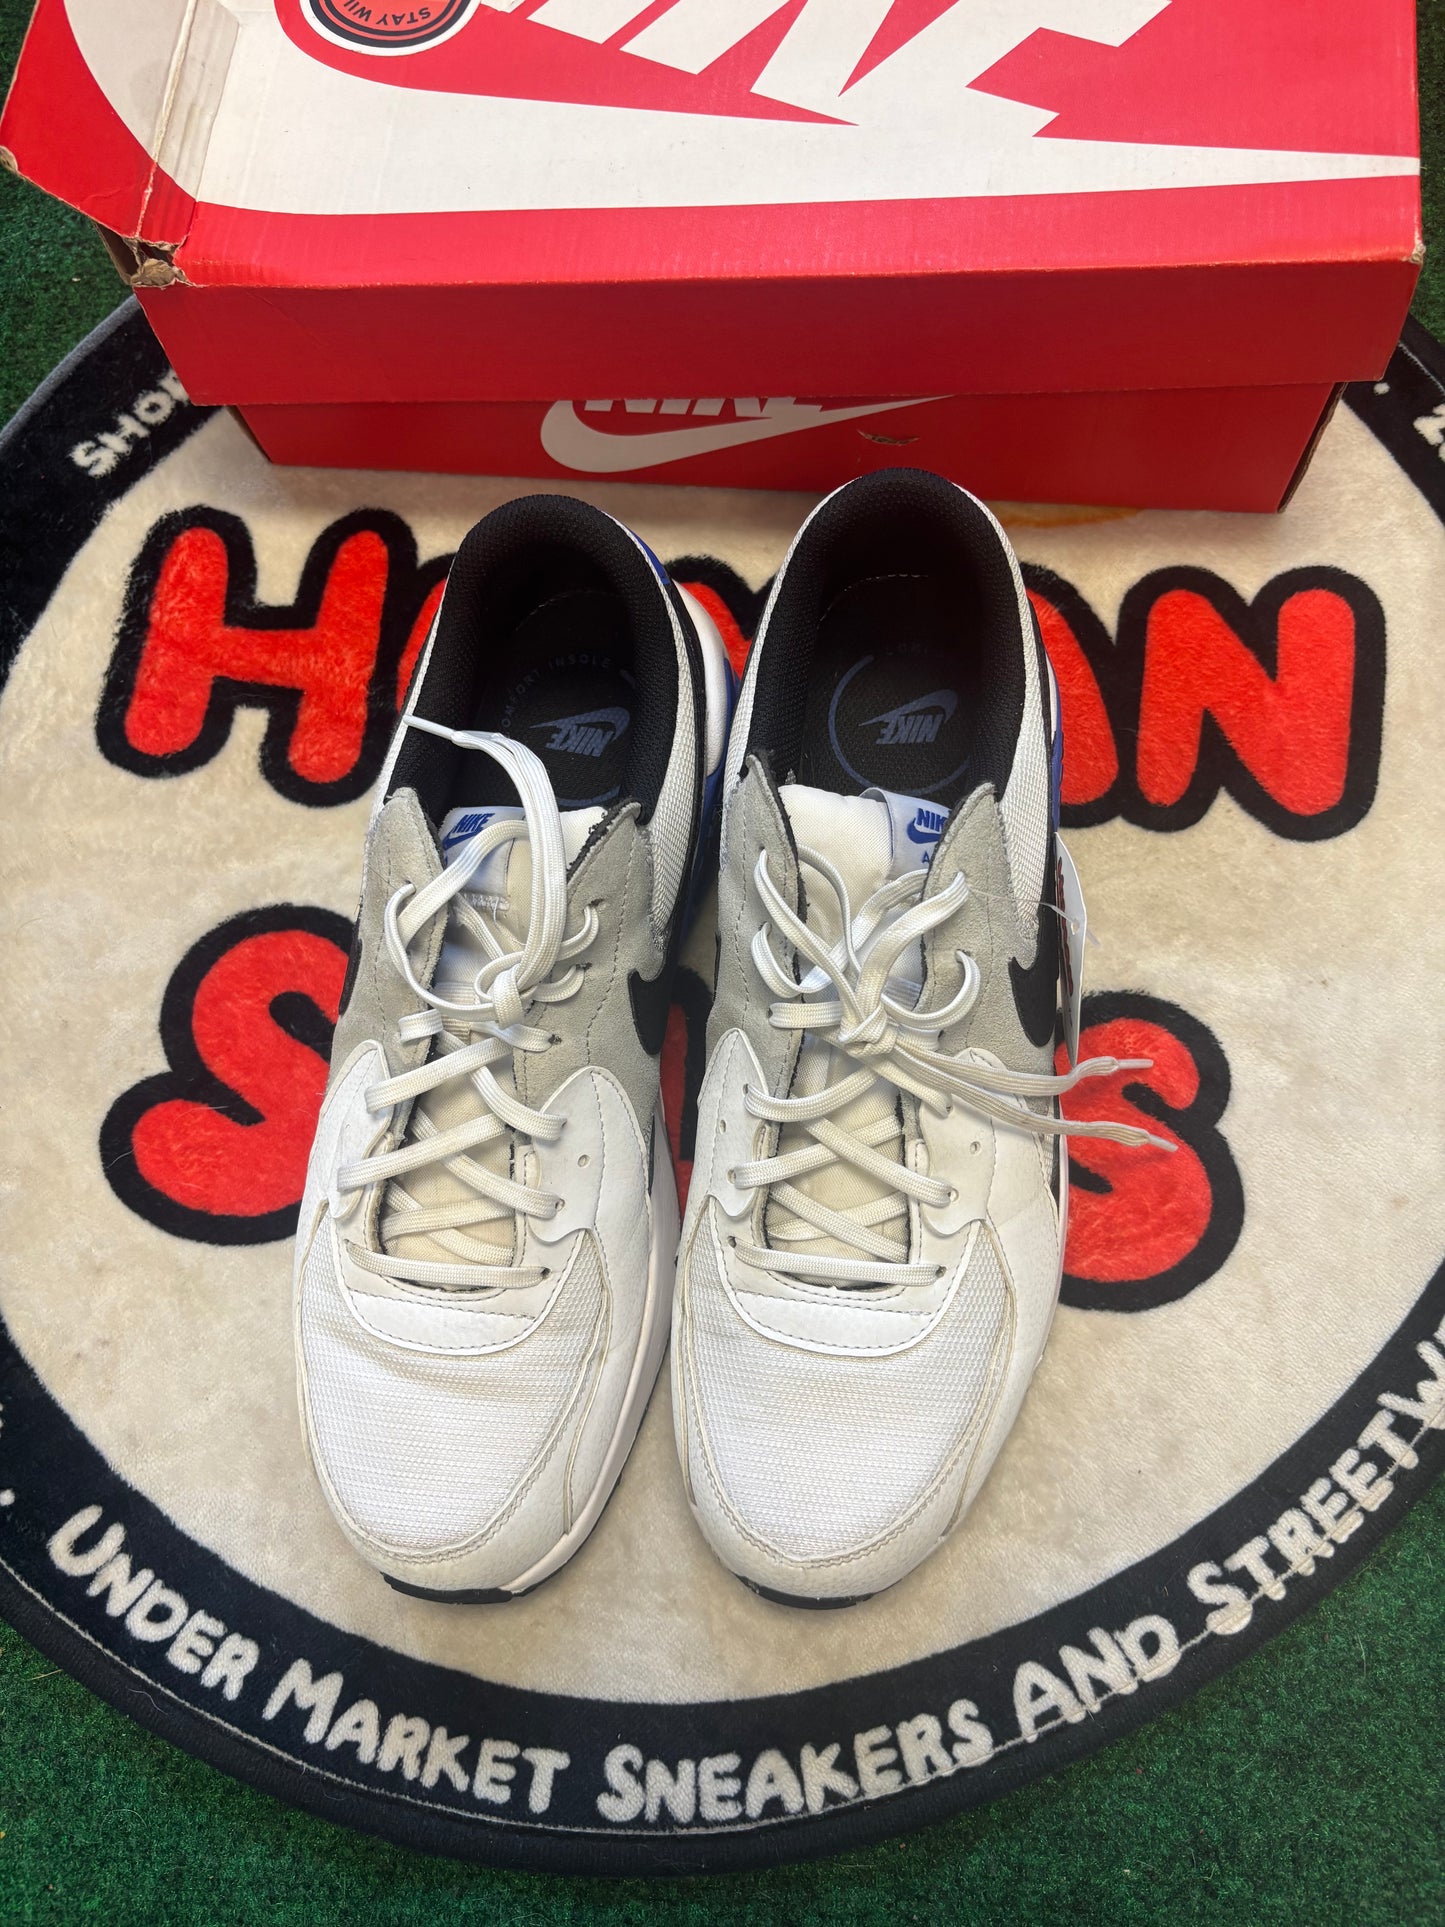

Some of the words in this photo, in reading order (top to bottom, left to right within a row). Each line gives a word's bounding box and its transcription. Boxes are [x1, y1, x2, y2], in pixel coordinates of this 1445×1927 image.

[375, 7, 431, 26] STAY
[545, 723, 614, 758] NIKE
[874, 711, 945, 745] NIKE
[916, 807, 948, 833] NIK
[48, 1504, 260, 1701] UNDER
[262, 1657, 571, 1814] MARKET
[597, 1699, 995, 1823] SNEAKERS
[1012, 1613, 1182, 1742] AND
[1186, 1313, 1445, 1635] STREETW
